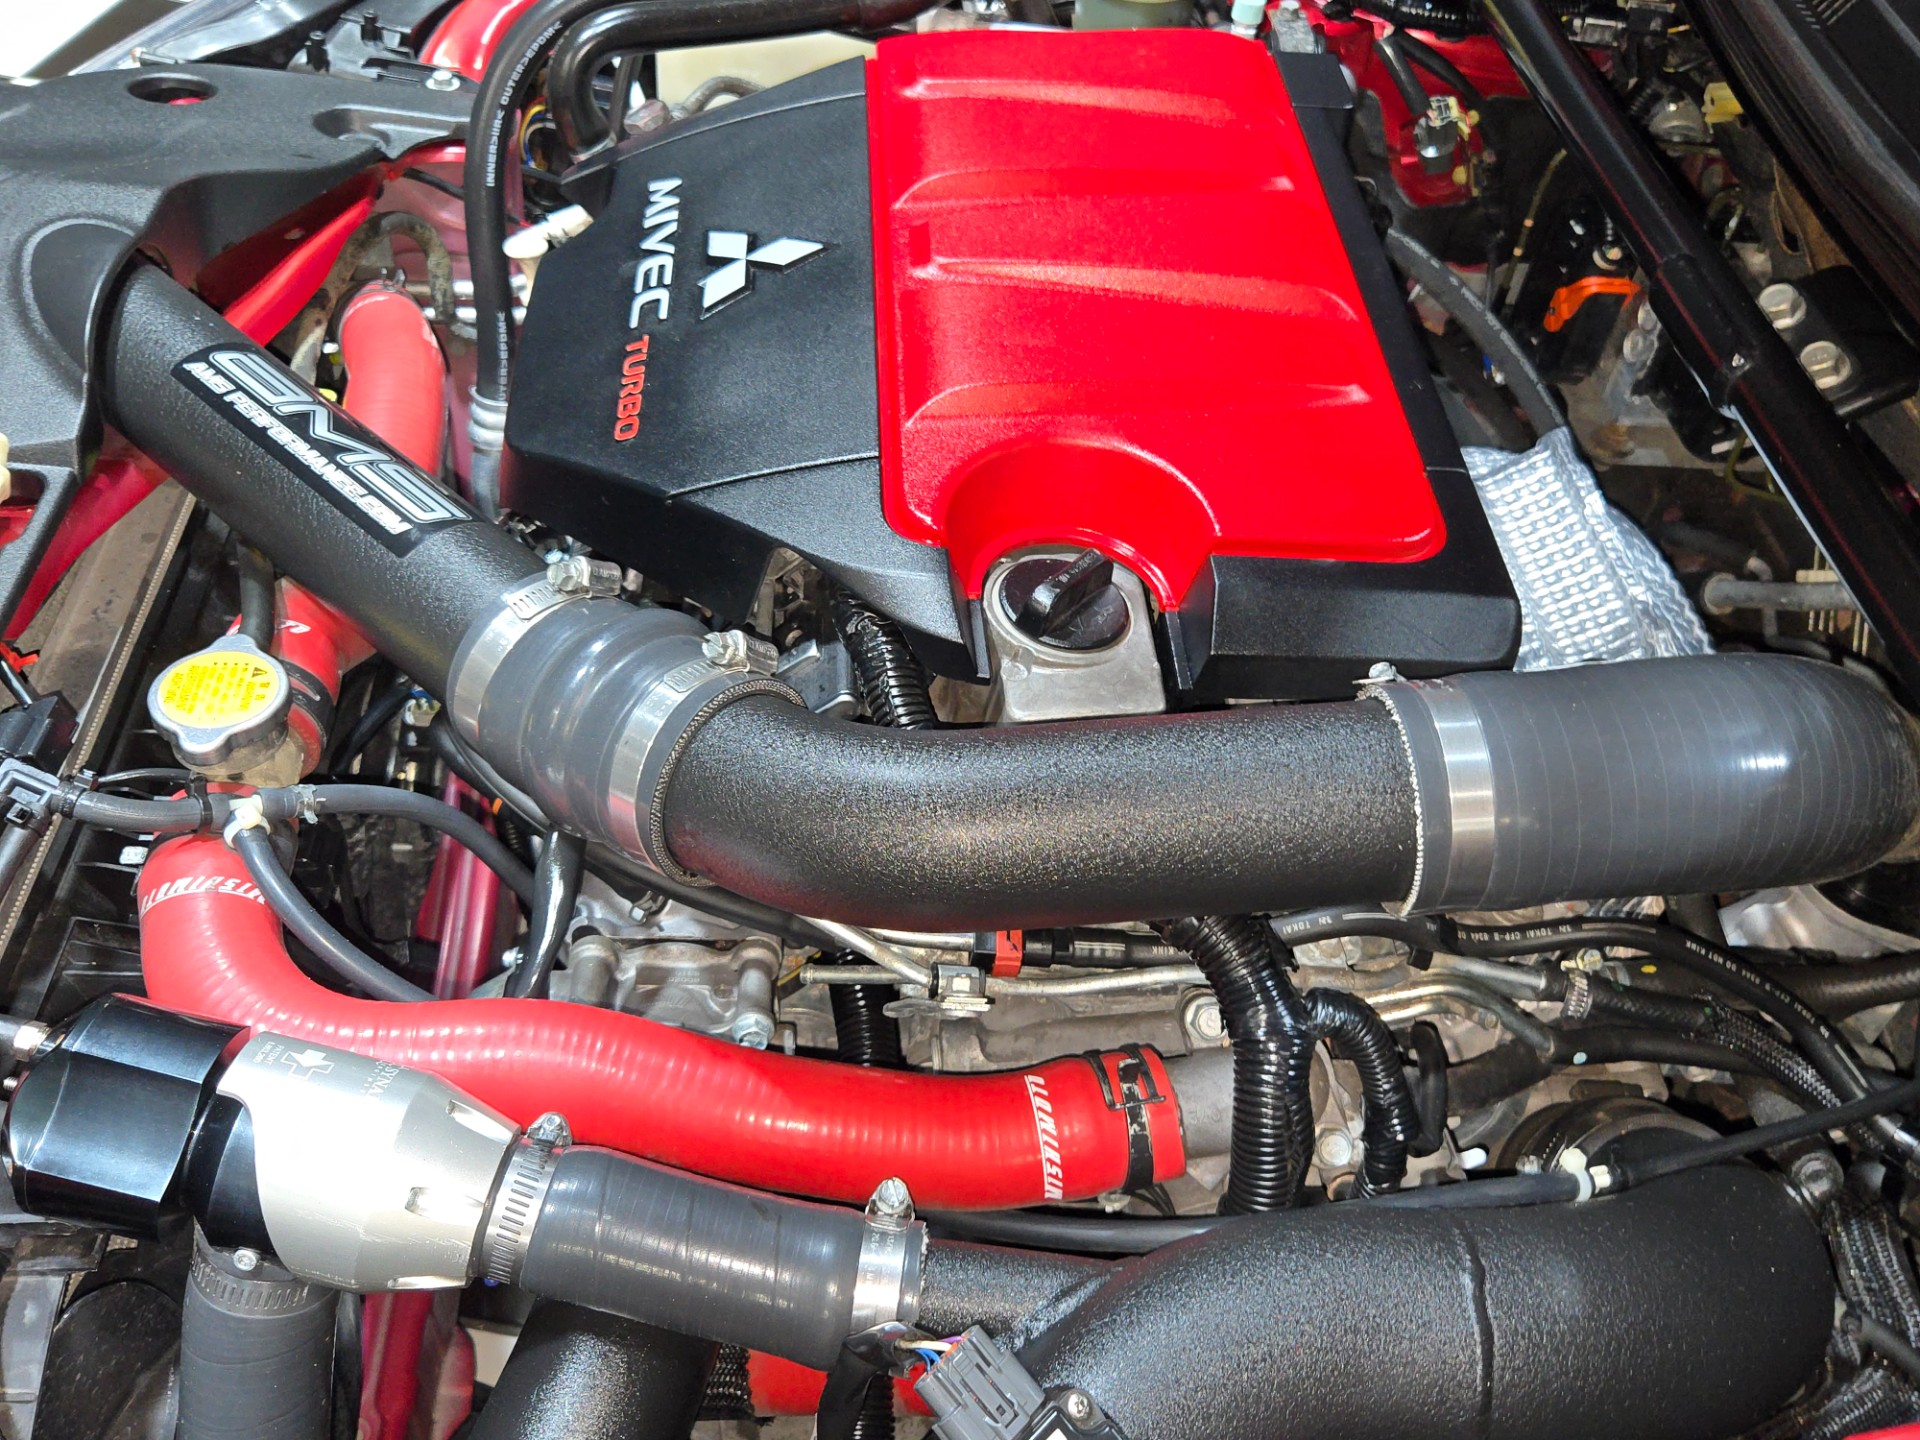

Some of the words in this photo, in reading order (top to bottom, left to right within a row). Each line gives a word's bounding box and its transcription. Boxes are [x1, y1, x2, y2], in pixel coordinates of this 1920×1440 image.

[629, 176, 683, 329] MIVEC
[613, 334, 650, 442] TURBO
[182, 361, 236, 394] AMS
[223, 389, 413, 535] PERFORMANCE.COM
[1282, 919, 1311, 935] TOKAI
[1526, 926, 1552, 939] TOKAI
[1150, 945, 1174, 956] KINK
[1685, 938, 1706, 957] KINK
[1708, 951, 1724, 966] NOT
[1725, 959, 1737, 973] DO
[1025, 1074, 1064, 1200] MISHIMOTO
